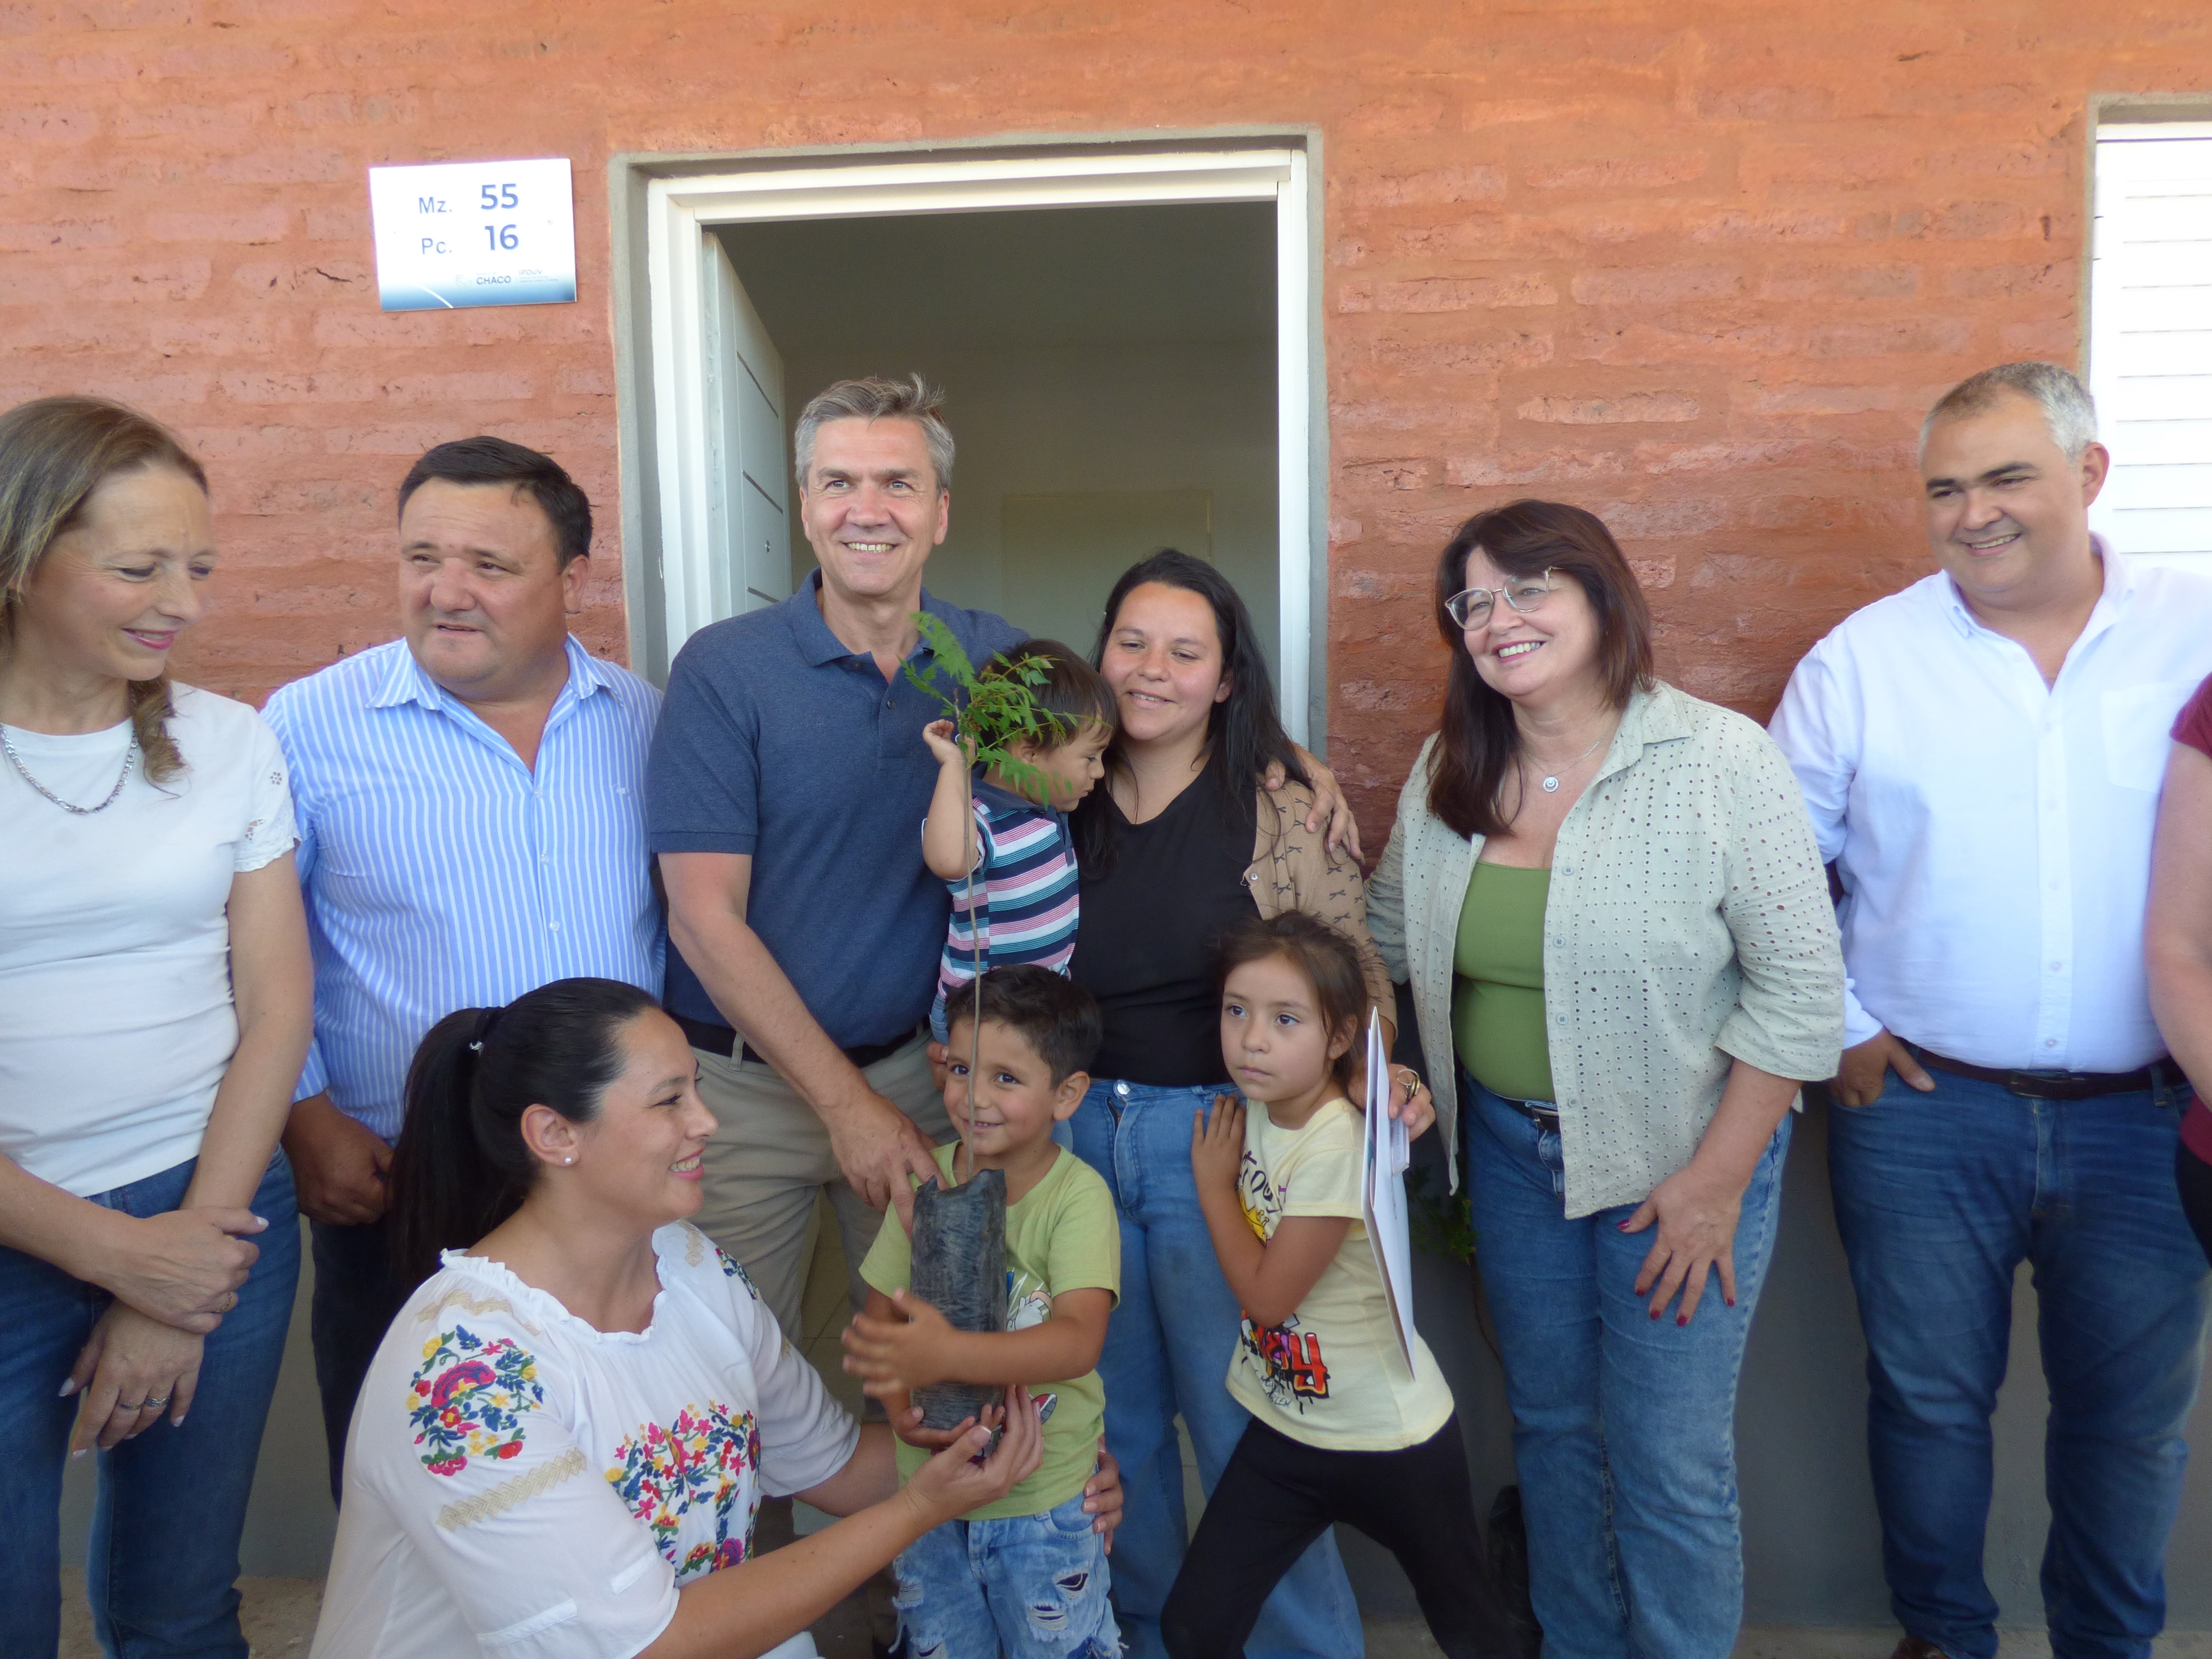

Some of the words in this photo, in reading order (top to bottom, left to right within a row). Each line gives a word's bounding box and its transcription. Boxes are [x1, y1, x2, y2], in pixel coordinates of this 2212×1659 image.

[419, 197, 452, 214] Mz.
[481, 183, 519, 210] 55
[421, 238, 452, 255] Pc.
[484, 224, 519, 251] 16
[476, 275, 512, 285] CHACO
